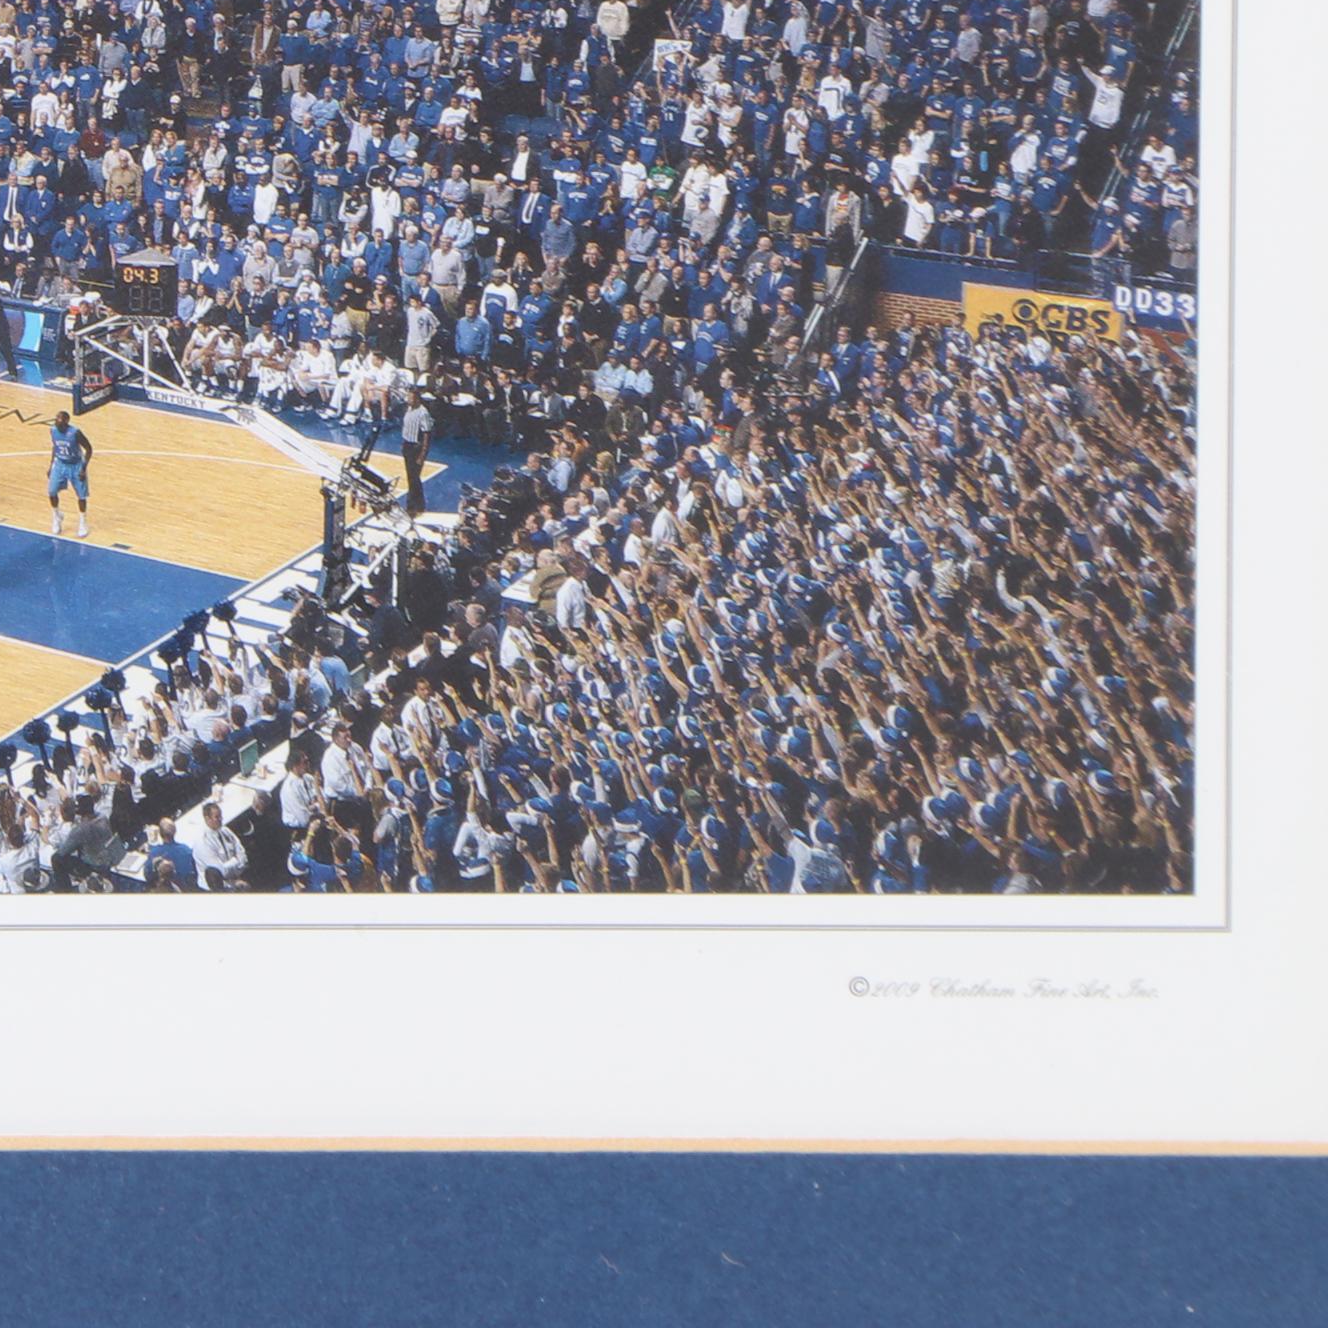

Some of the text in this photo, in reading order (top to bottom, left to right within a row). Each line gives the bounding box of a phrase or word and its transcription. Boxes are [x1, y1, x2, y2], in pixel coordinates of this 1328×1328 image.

[123, 267, 160, 284] 04.3
[1042, 303, 1111, 334] CBS
[147, 390, 206, 409] KENTUCKY
[929, 977, 1016, 999] Chatham
[1023, 978, 1067, 1000] Fine
